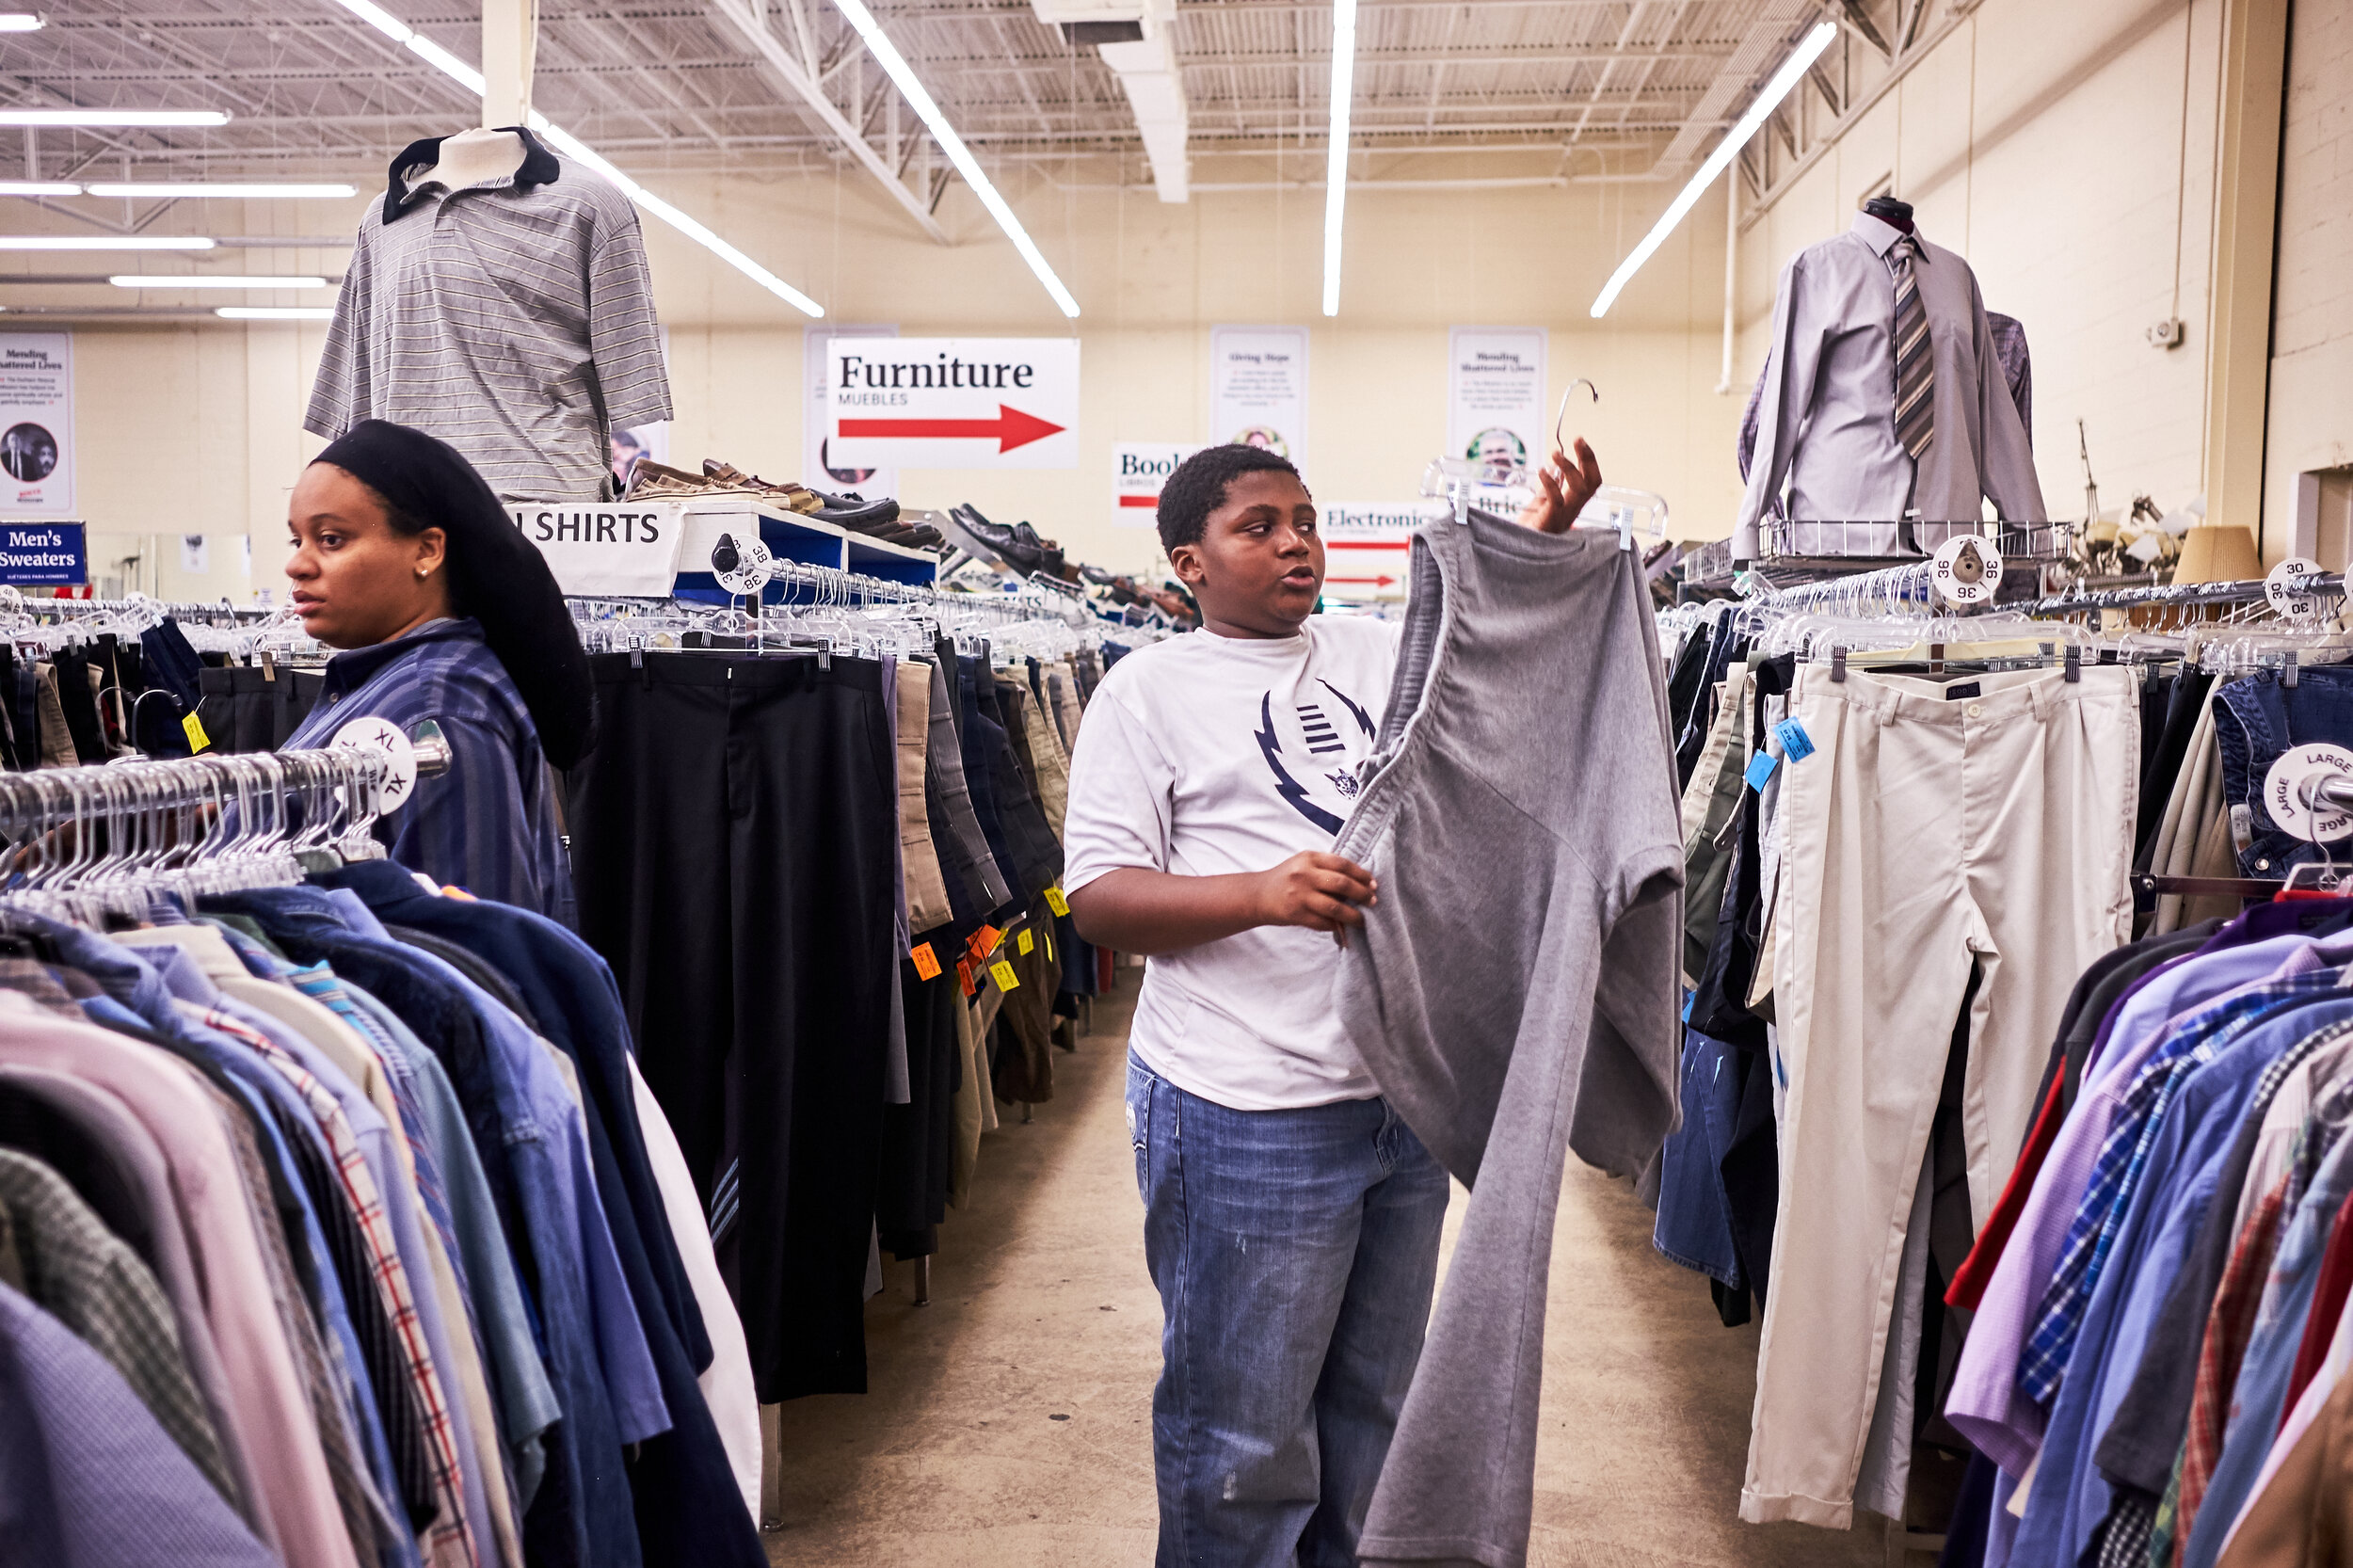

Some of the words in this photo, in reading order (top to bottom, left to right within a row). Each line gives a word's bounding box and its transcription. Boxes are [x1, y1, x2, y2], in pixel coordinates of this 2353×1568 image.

[7, 349, 47, 361] Mending
[0, 361, 36, 370] hattered
[39, 361, 62, 370] Lives
[840, 353, 1033, 388] Furniture
[839, 393, 908, 406] MUEBLES
[536, 512, 659, 543] SHIRTS
[8, 529, 62, 547] Men's
[0, 552, 75, 567] Sweaters
[753, 546, 768, 564] 38
[1938, 560, 1950, 579] 36
[1986, 560, 1998, 579] 36
[2286, 563, 2304, 574] 30
[744, 574, 762, 590] 38
[1958, 587, 1977, 599] 36
[2271, 583, 2283, 600] 30
[2291, 602, 2309, 615] 30
[375, 727, 394, 753] XL
[2307, 754, 2353, 774] LARGE
[384, 772, 407, 794] XL
[2276, 776, 2296, 818] LARGE
[2319, 812, 2353, 832] ARGE
